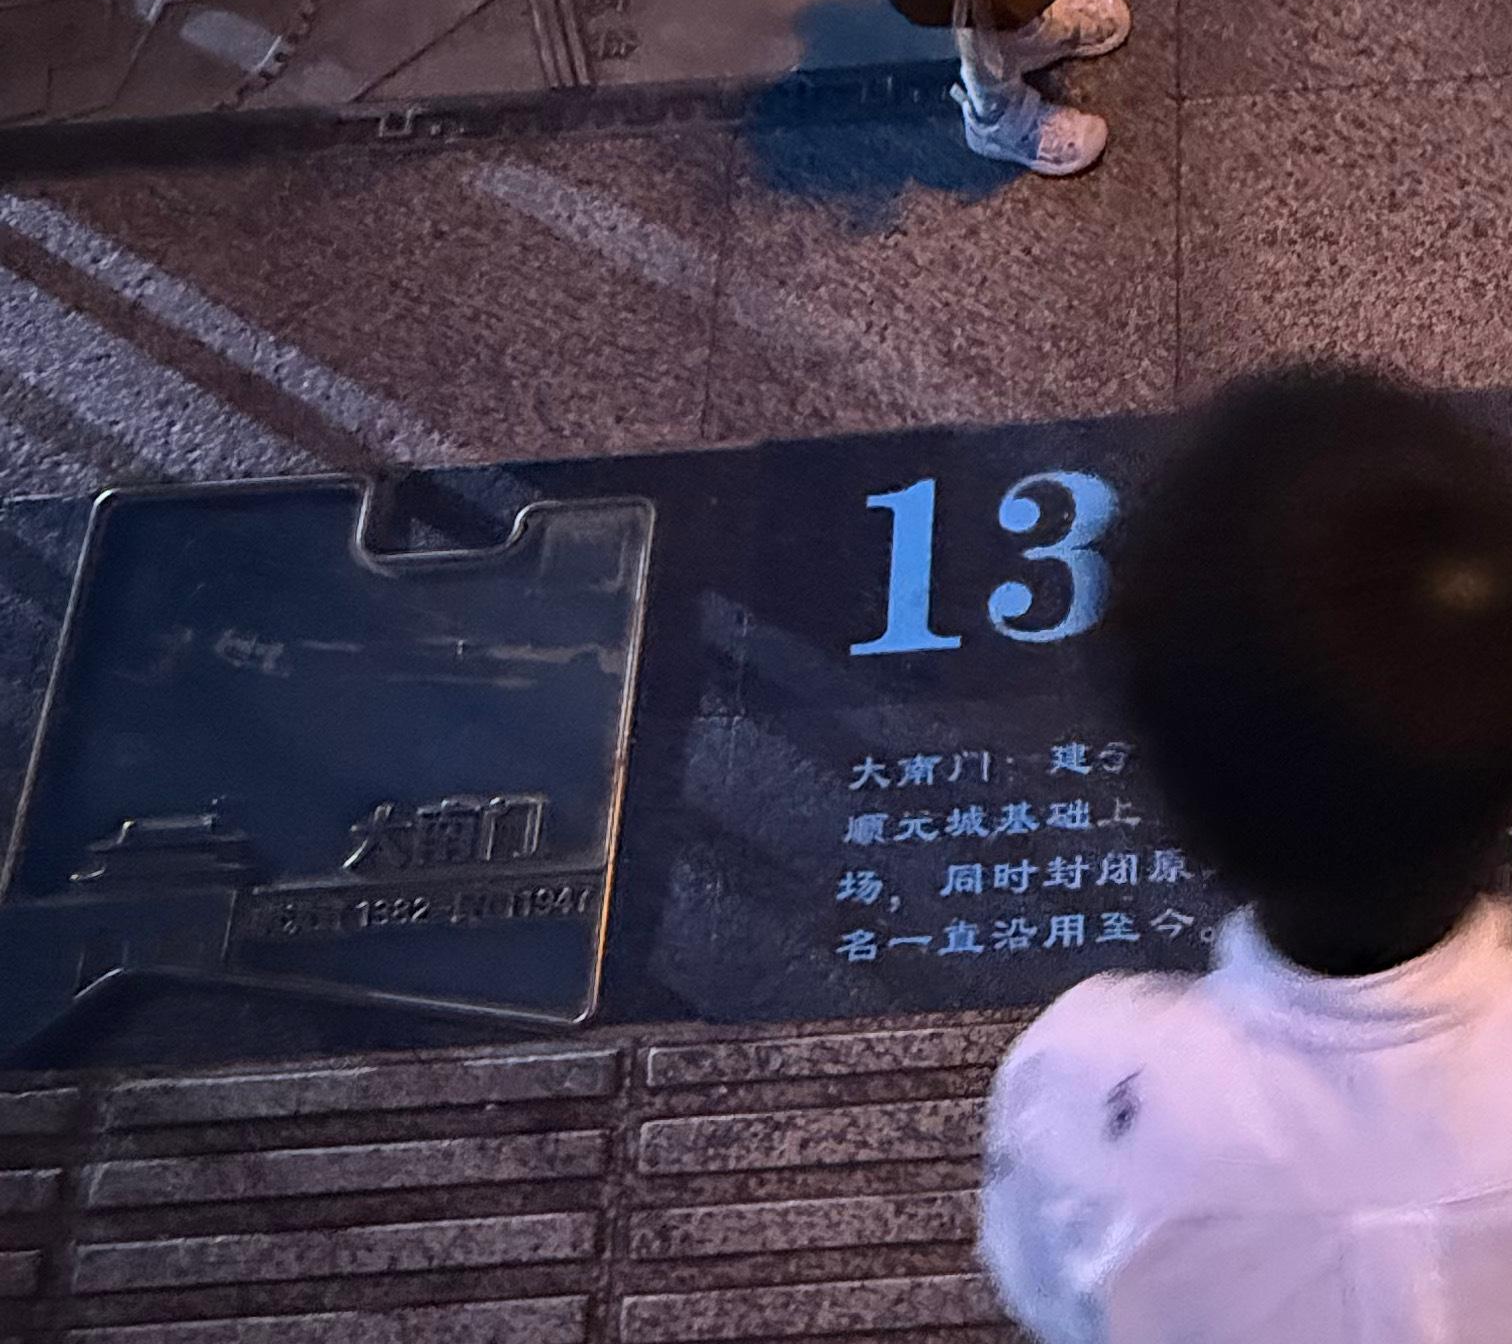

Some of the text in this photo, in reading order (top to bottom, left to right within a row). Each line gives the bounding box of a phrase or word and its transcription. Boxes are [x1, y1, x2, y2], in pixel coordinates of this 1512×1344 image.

[848, 469, 1122, 657] 13
[842, 796, 1143, 846] 顺元城基础上
[834, 906, 1216, 963] 名一直沿用至今。
